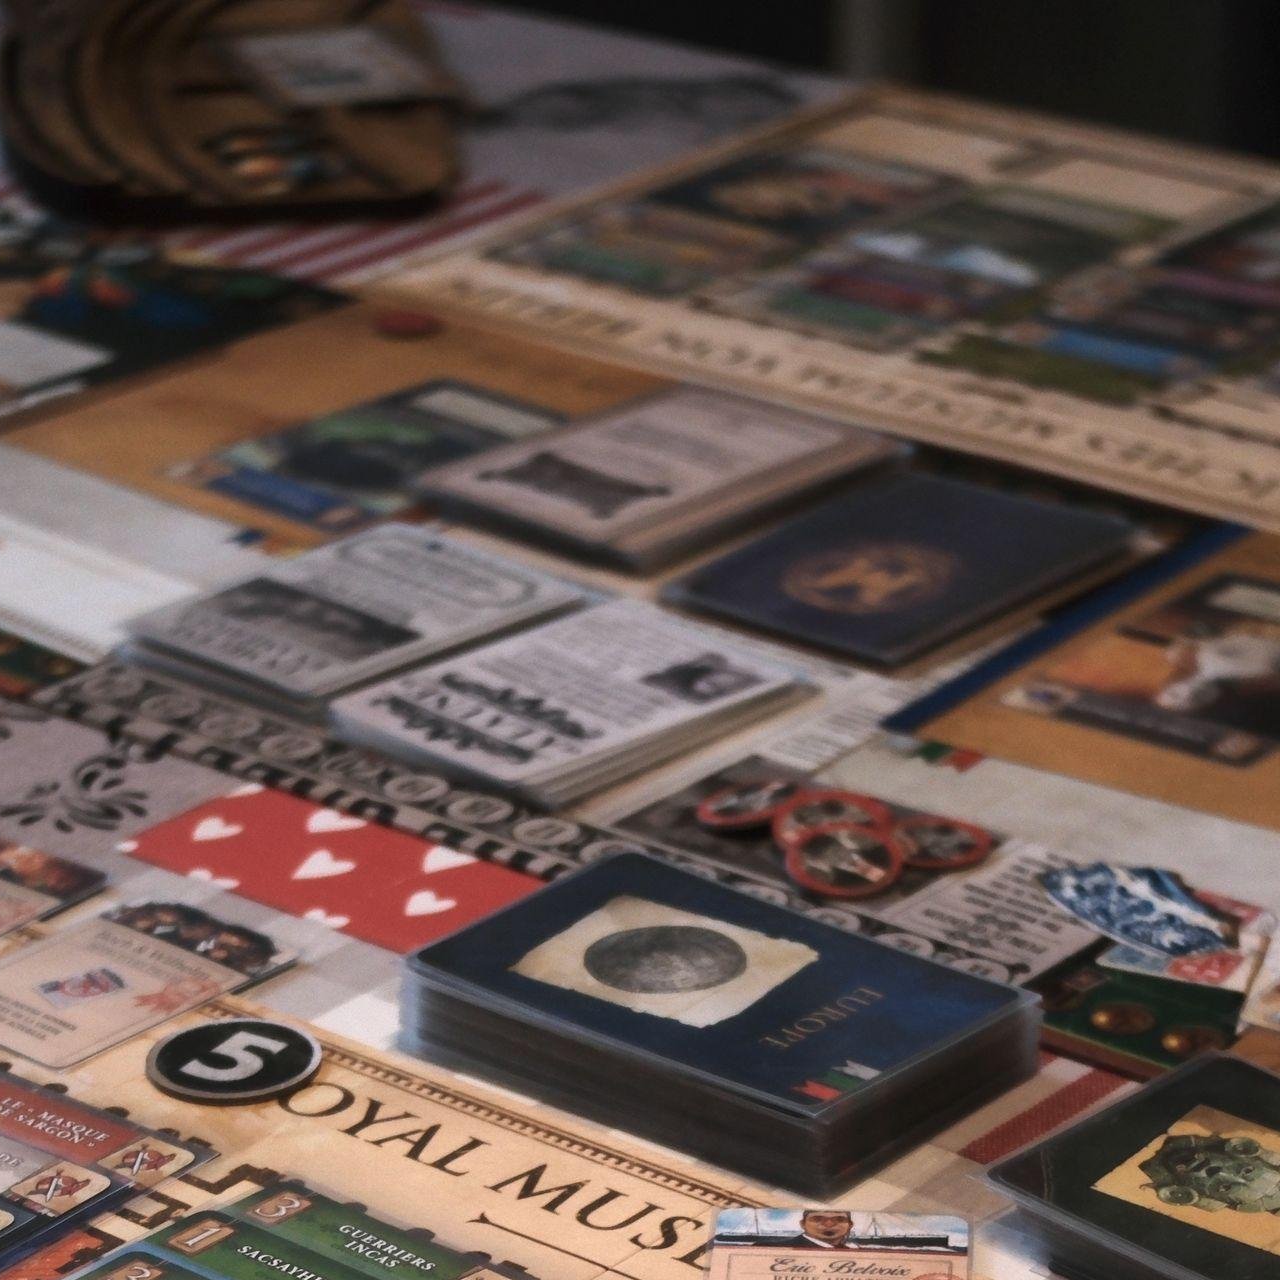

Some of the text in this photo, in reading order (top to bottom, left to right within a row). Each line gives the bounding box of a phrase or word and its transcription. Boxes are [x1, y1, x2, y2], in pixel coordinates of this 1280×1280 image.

[760, 985, 884, 1050] EUROPE
[178, 1031, 290, 1083] 5
[37, 1109, 110, 1143] MASQUE
[279, 1083, 489, 1178] OYAL
[482, 1160, 711, 1272] MUS
[255, 1196, 302, 1217] 3
[185, 1226, 222, 1247] 1
[338, 1223, 437, 1273] GUERRIERS
[344, 1239, 401, 1269] INCAS
[769, 1256, 817, 1275] Eric
